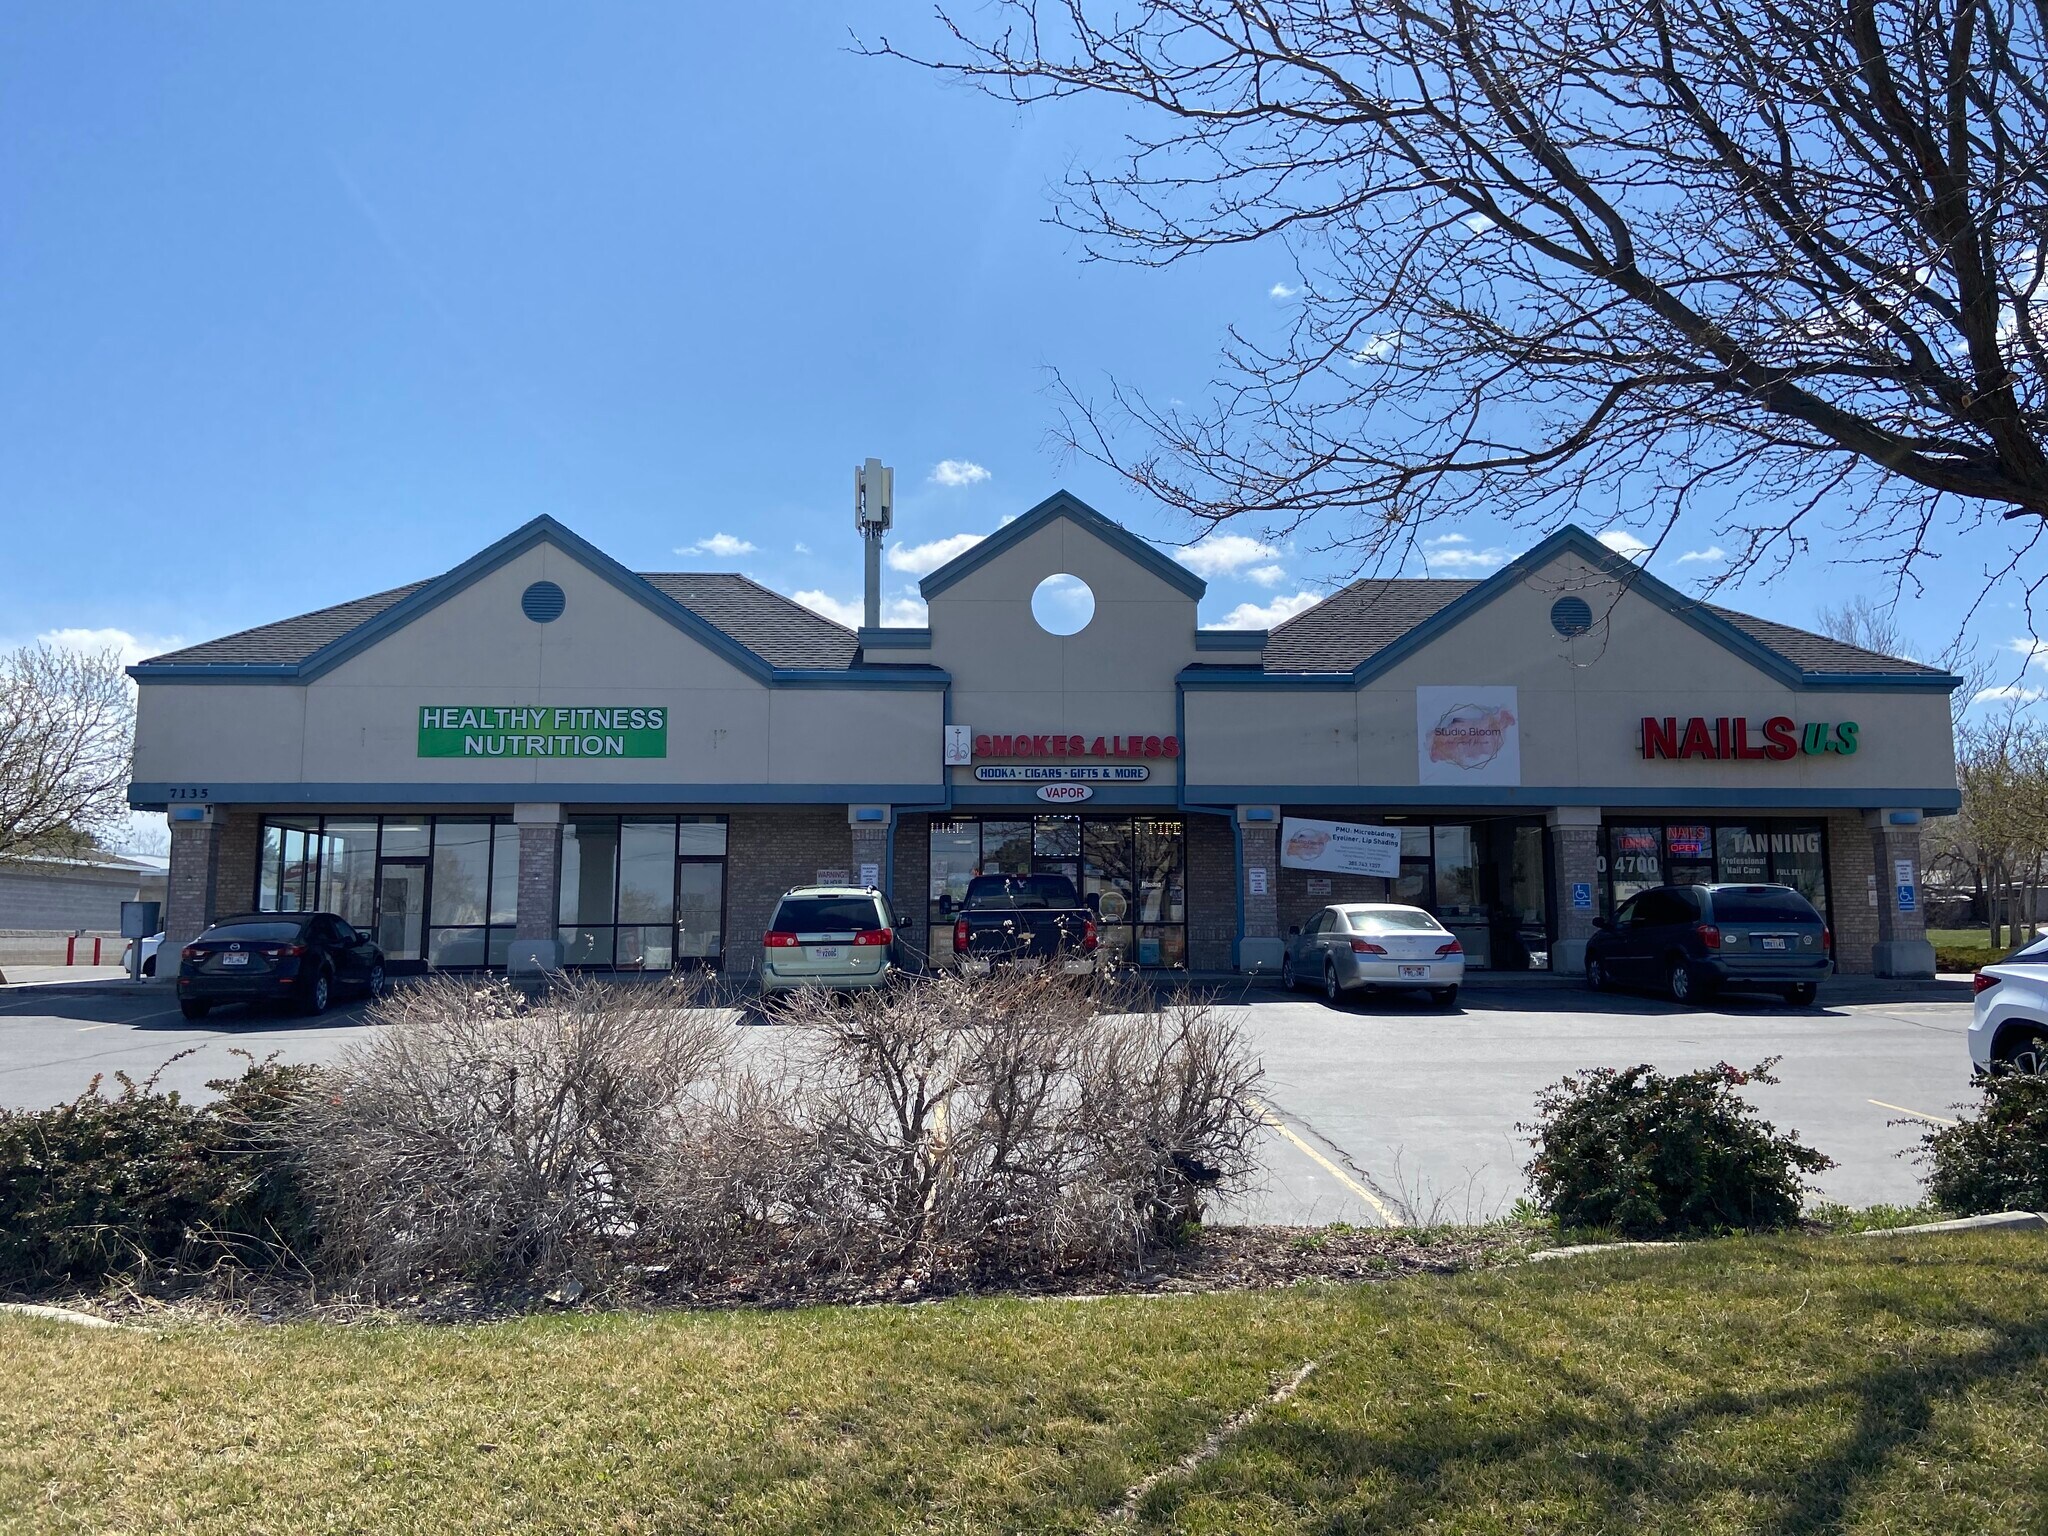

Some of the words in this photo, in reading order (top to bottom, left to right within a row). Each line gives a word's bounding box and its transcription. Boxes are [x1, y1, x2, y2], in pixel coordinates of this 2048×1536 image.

[422, 707, 547, 730] HEALTHY
[554, 708, 664, 730] FITNESS
[1434, 727, 1467, 737] Studio
[1469, 727, 1501, 737] Bloom
[1641, 716, 1797, 761] NAILS
[464, 735, 625, 755] NUTRITION
[975, 735, 1086, 758] SMOKES
[1091, 736, 1107, 759] 4
[1113, 735, 1181, 759] LESS
[980, 768, 1017, 779] HOOKA
[1024, 768, 1062, 779] CIGARS
[1070, 768, 1099, 779] GIFTS
[1103, 768, 1110, 778] &
[1115, 768, 1144, 779] MORE
[170, 788, 208, 799] 7135
[1045, 787, 1085, 798] VAPOR
[1353, 828, 1397, 840] Microblading,
[1667, 827, 1705, 839] NAILS
[1332, 834, 1361, 844] Eyeliner,
[1362, 837, 1372, 845] Lip
[1373, 838, 1399, 848] Shading
[1731, 833, 1820, 853] TANNING
[1670, 843, 1699, 853] OPEN
[1614, 856, 1659, 874] 4700
[1721, 857, 1767, 865] Professional
[1727, 866, 1741, 874] Nail
[1743, 866, 1761, 874] Care
[1776, 868, 1790, 876] FULL
